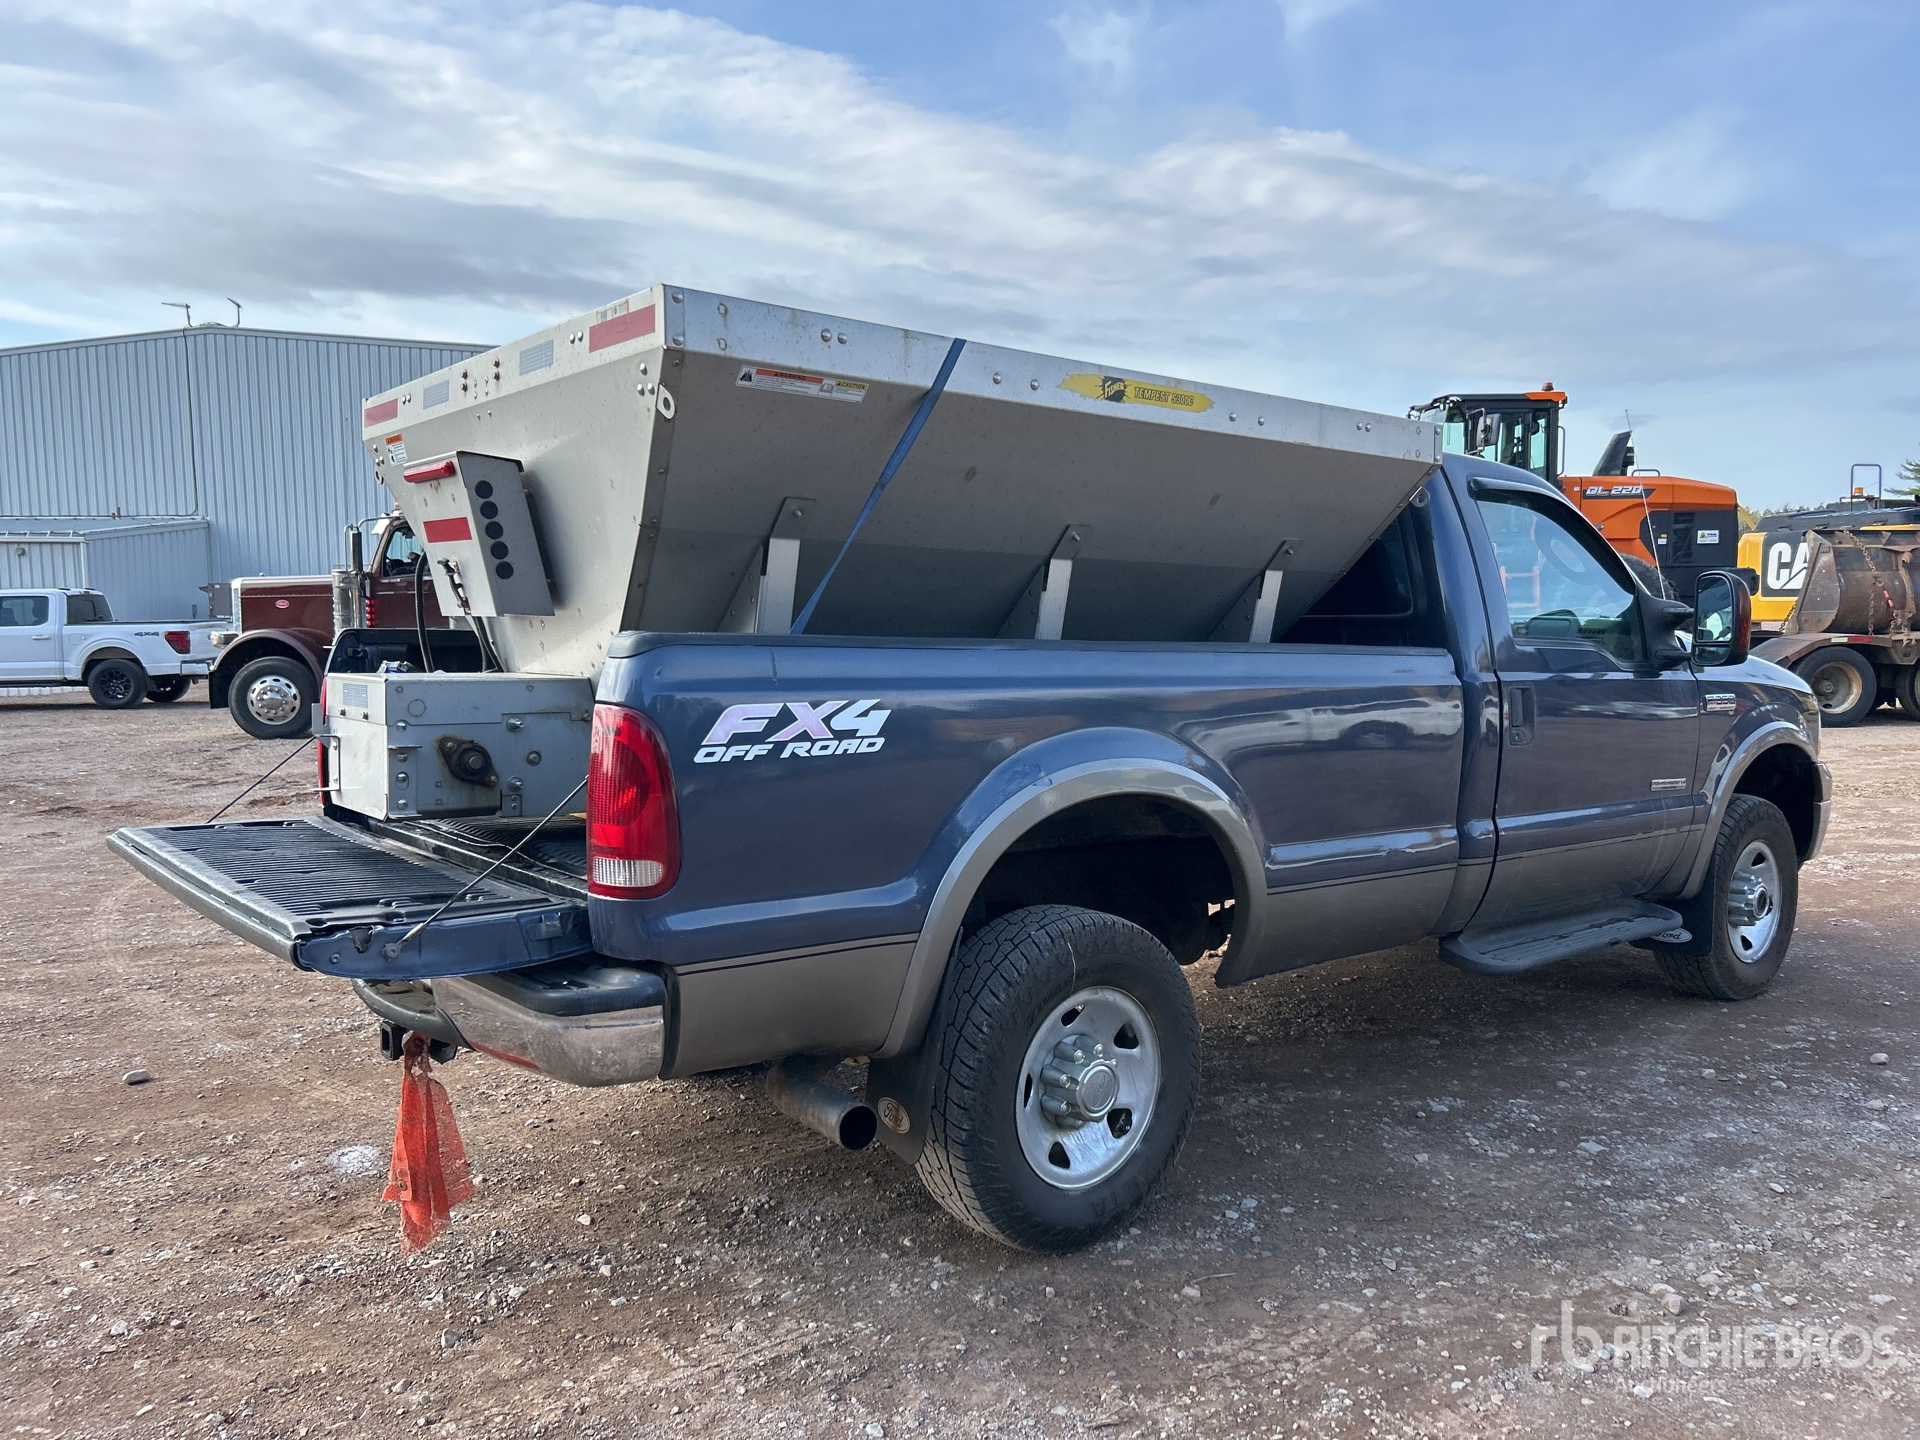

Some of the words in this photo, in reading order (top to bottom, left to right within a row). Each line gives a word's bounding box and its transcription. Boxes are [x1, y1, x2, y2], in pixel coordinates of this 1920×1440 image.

[841, 381, 866, 390] CAUTION
[1134, 386, 1170, 403] TEMPEST
[1585, 485, 1611, 497] DL
[1611, 485, 1643, 496] 220
[1767, 542, 1809, 590] CA
[701, 698, 892, 746] FX4
[694, 744, 775, 764] OFF
[780, 737, 886, 759] ROAD
[884, 1102, 904, 1127] Ford
